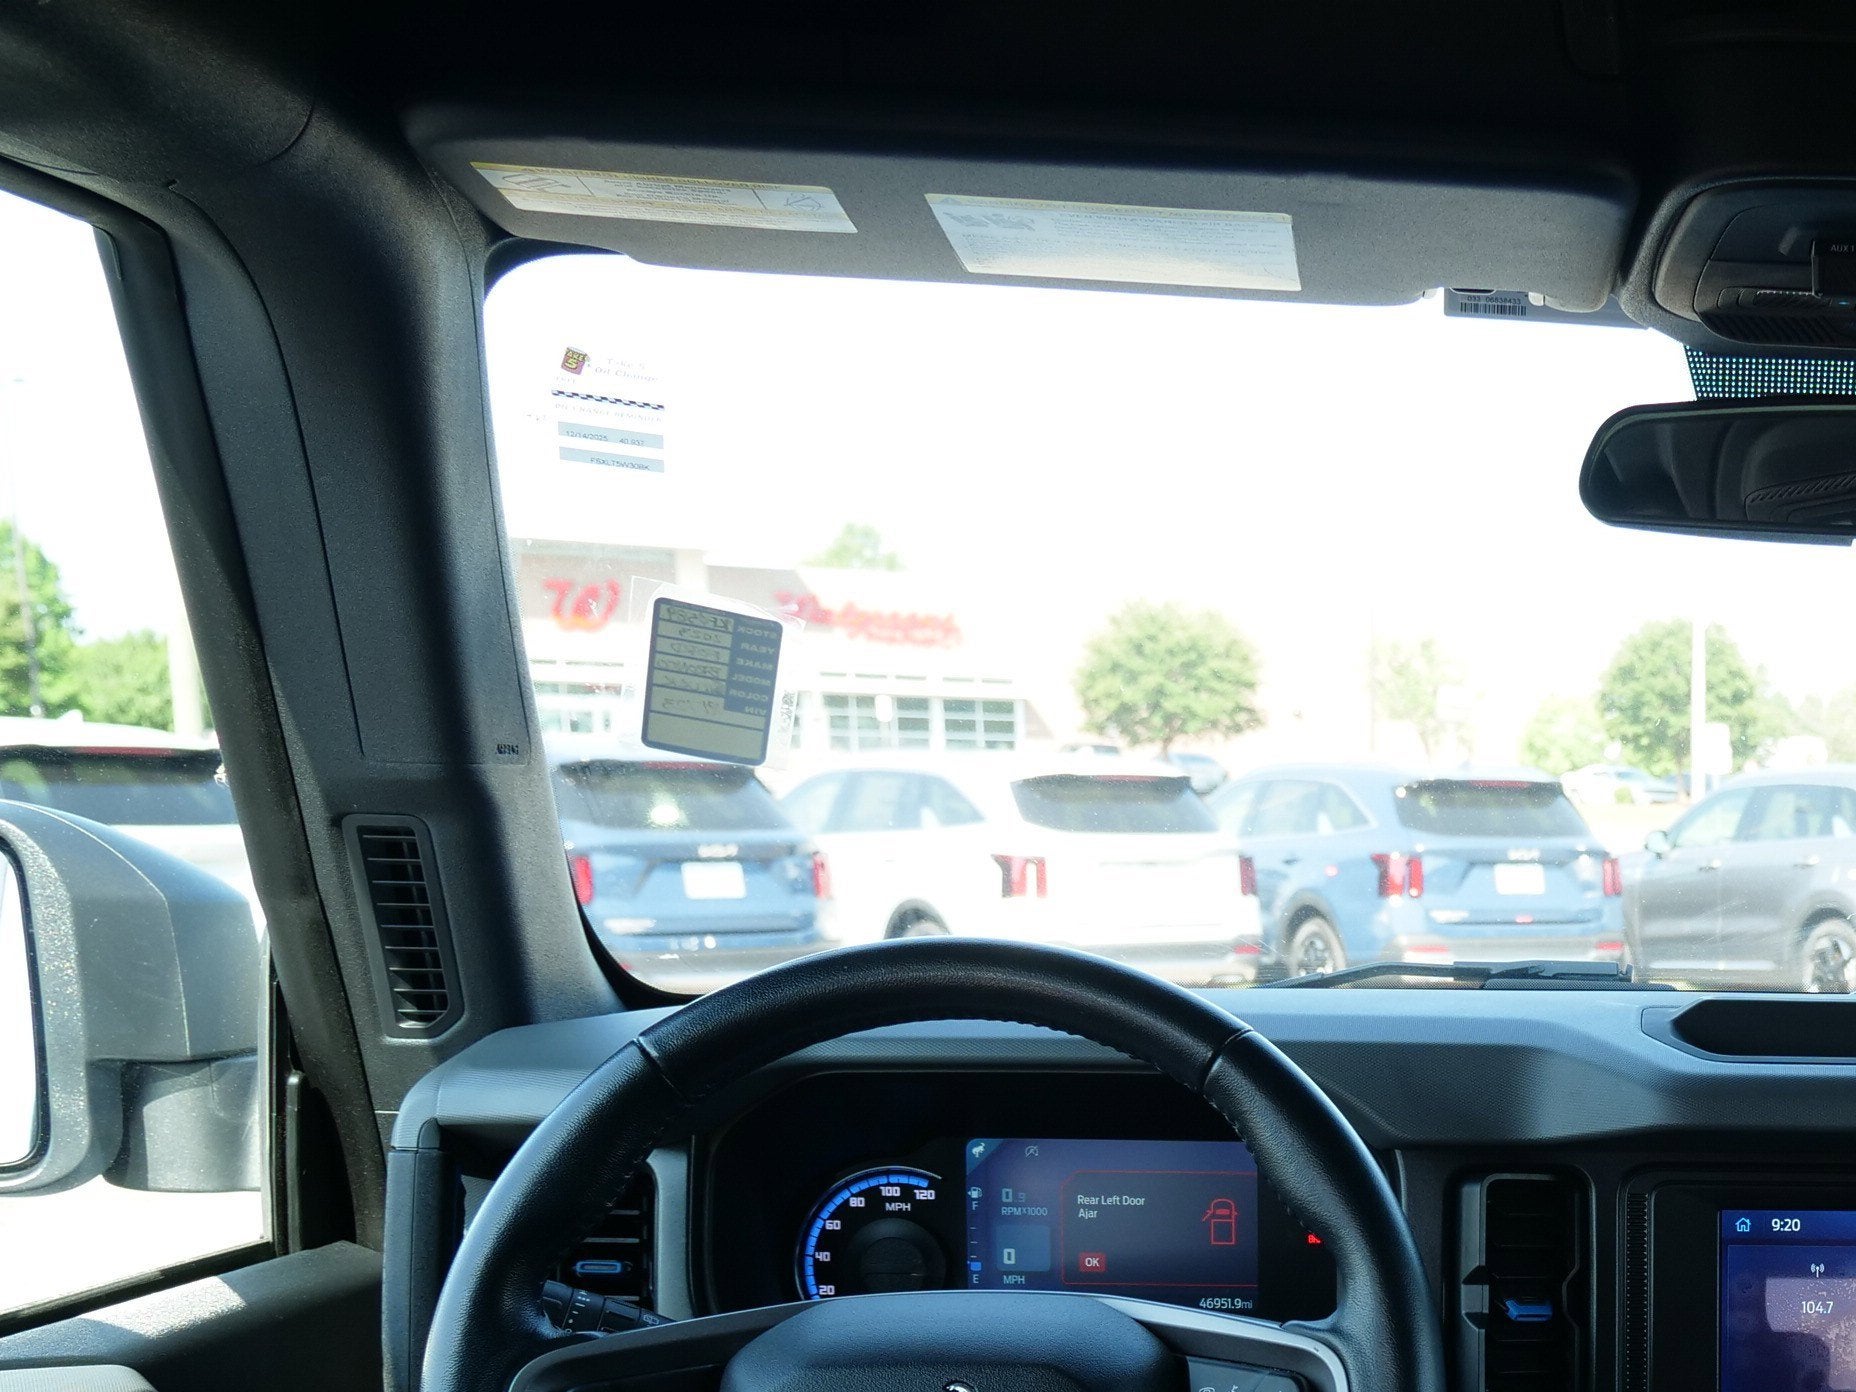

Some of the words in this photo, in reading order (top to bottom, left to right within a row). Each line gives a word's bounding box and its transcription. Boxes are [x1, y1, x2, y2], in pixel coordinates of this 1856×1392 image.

[879, 1186, 901, 1197] 100
[913, 1189, 936, 1200] 120
[849, 1197, 865, 1207] 80
[1077, 1194, 1099, 1205] Rear
[1101, 1194, 1121, 1205] Left
[1122, 1195, 1146, 1206] Door
[885, 1202, 911, 1211] MPH
[971, 1201, 979, 1210] F
[1078, 1208, 1098, 1219] Ajar
[825, 1220, 841, 1230] 60
[1771, 1218, 1801, 1233] 9:20
[814, 1251, 831, 1262] 40
[1003, 1248, 1016, 1265] 0
[1085, 1257, 1100, 1267] OK
[972, 1274, 979, 1284] E
[1003, 1275, 1026, 1284] MPH
[819, 1285, 835, 1295] 20
[1801, 1301, 1834, 1314] 104.7
